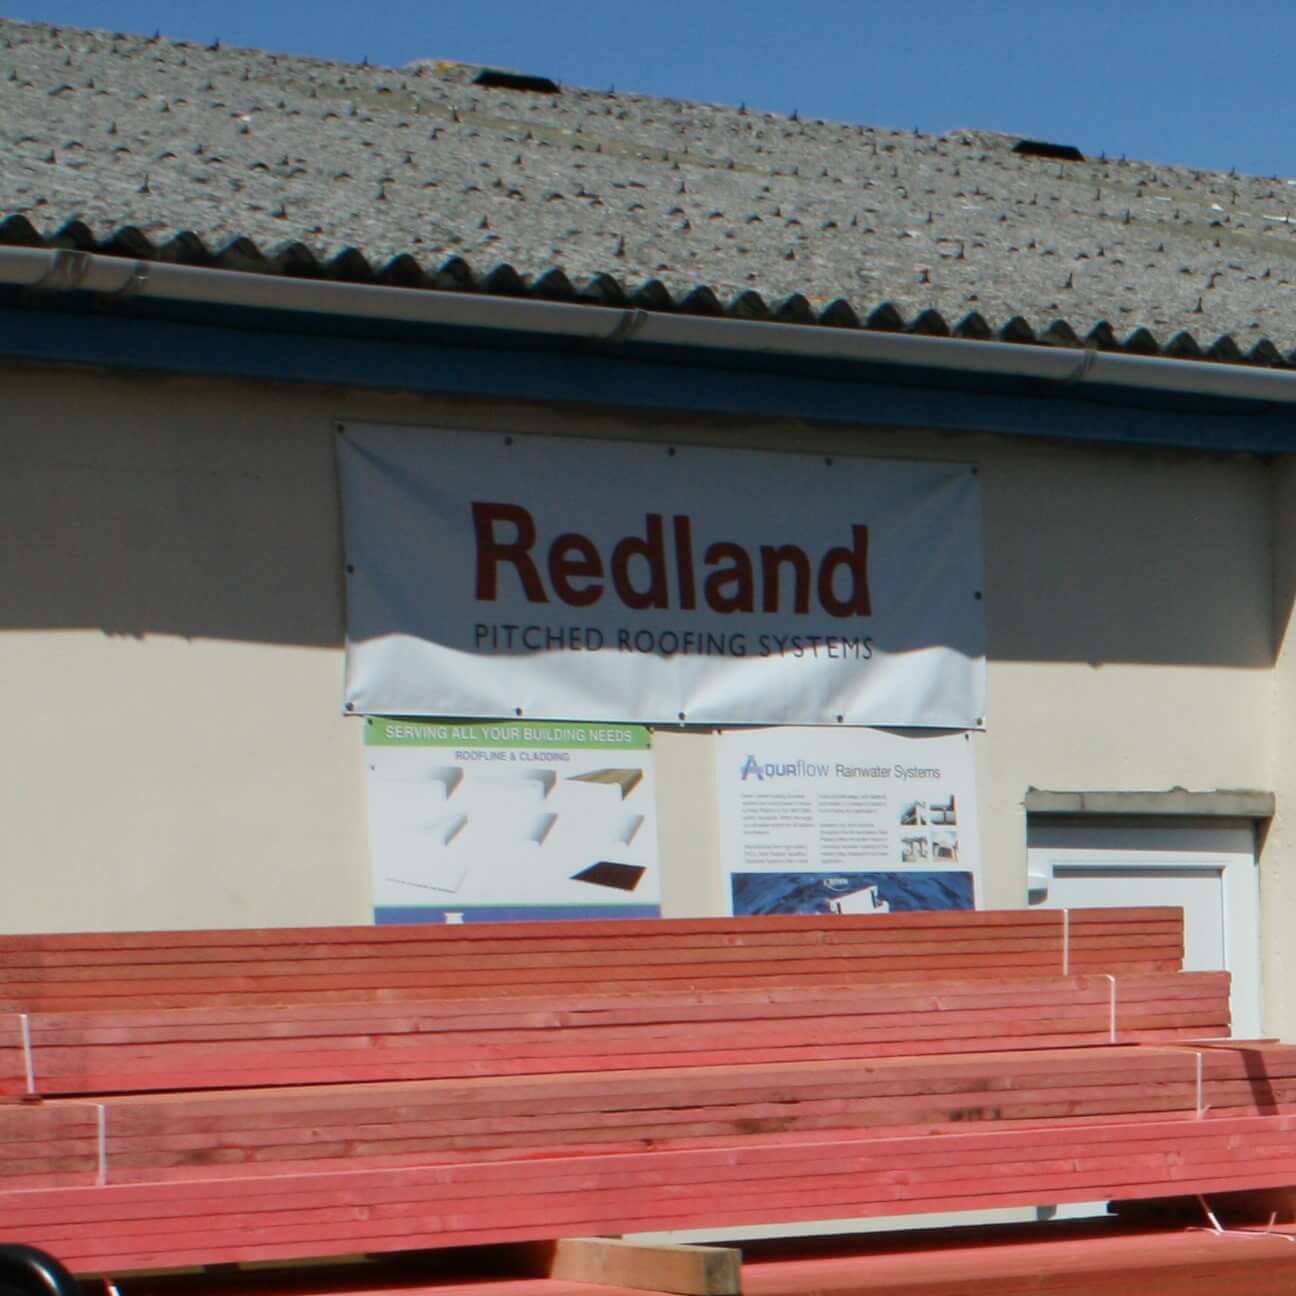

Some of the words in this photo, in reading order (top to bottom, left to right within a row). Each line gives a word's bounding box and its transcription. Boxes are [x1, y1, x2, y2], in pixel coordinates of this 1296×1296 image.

[471, 501, 872, 618] Redland
[474, 623, 605, 652] PITCHED
[617, 628, 747, 658] ROOFING
[758, 633, 873, 661] SYSTEMS
[385, 725, 448, 740] SERVING
[450, 726, 477, 740] ALL
[482, 727, 520, 741] YOUR
[523, 727, 585, 742] BUILDING
[590, 729, 632, 743] NEEDS
[455, 751, 506, 761] ROOFLINE
[519, 751, 570, 762] CLADDING
[836, 763, 891, 779] Rainwater
[894, 764, 941, 781] Systems
